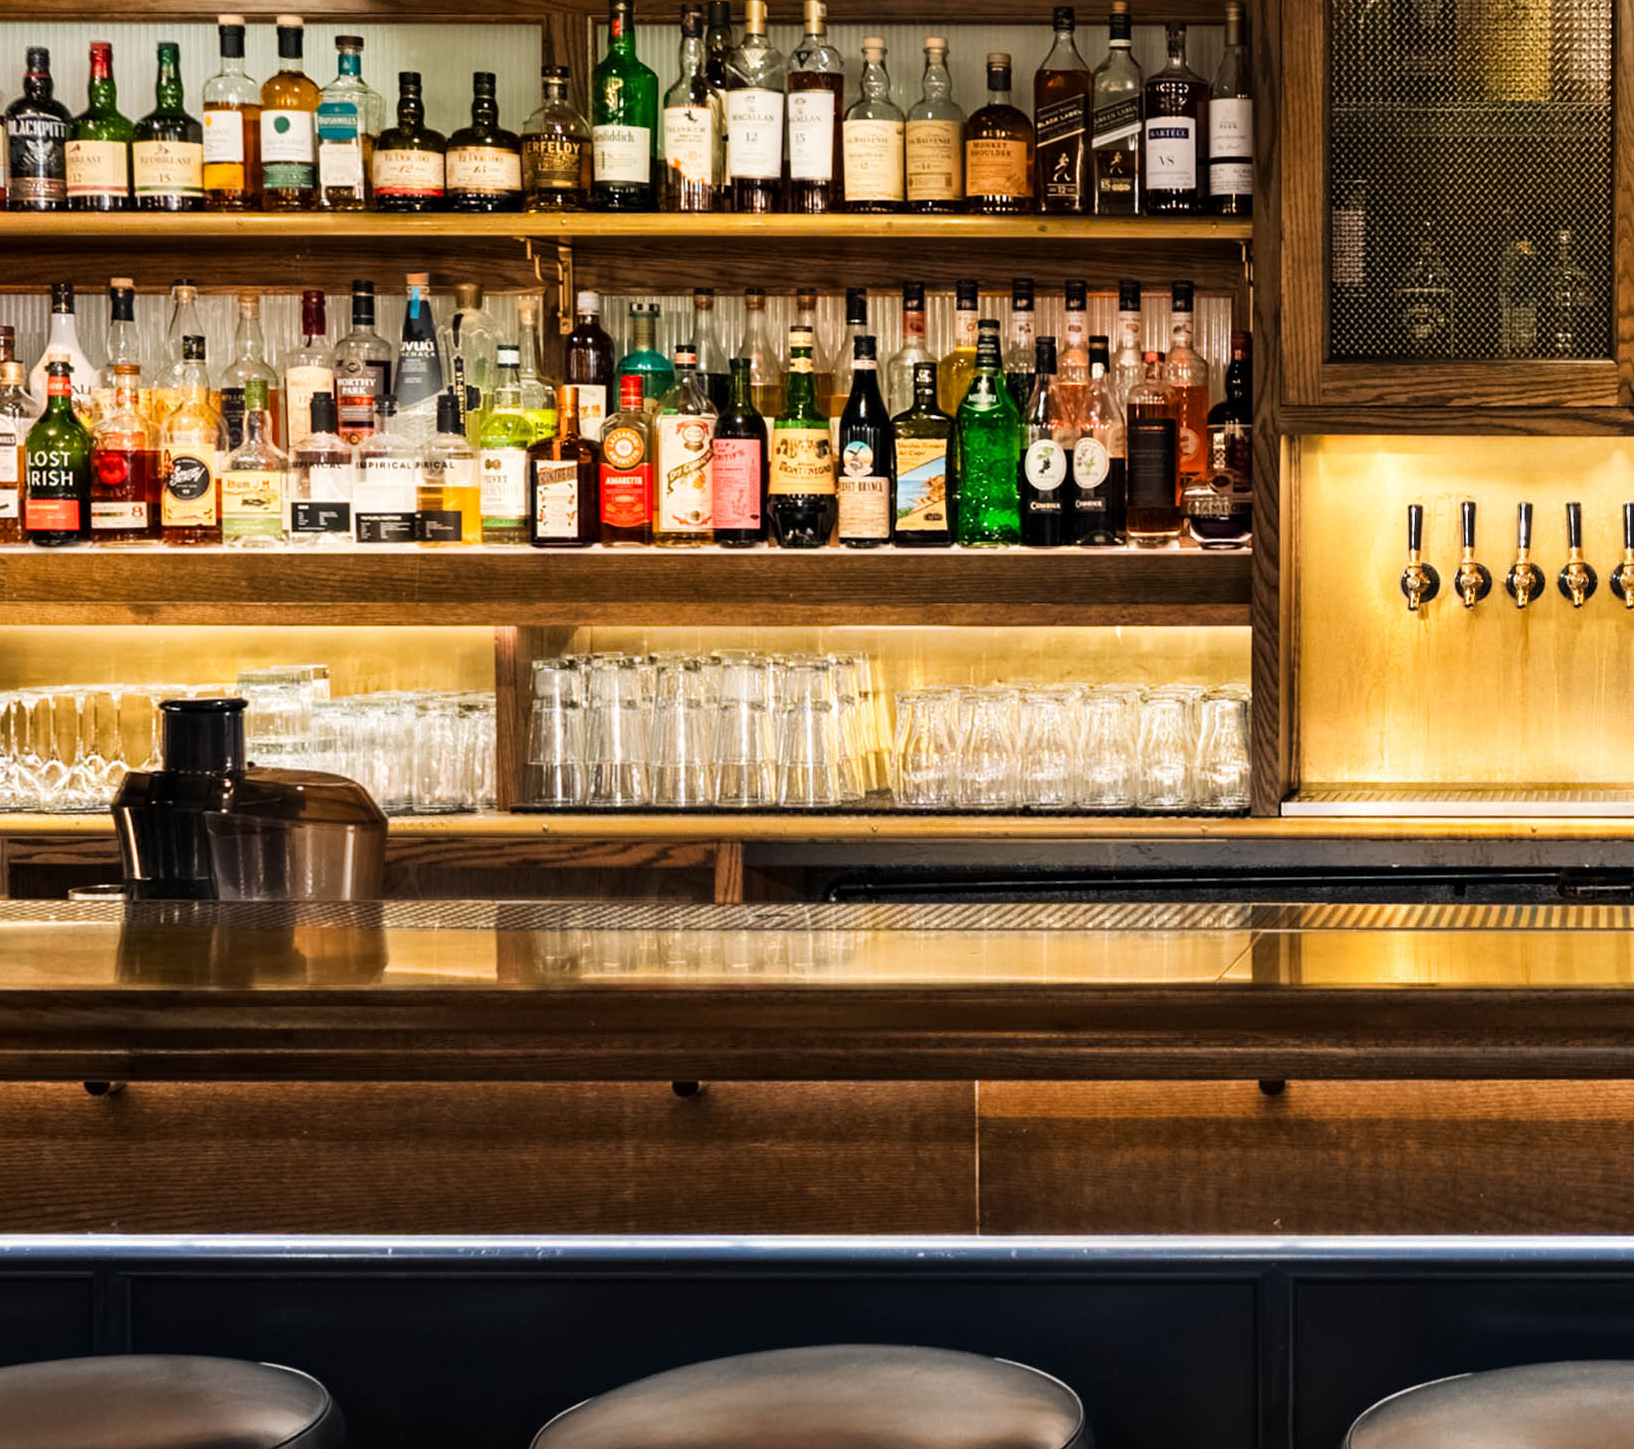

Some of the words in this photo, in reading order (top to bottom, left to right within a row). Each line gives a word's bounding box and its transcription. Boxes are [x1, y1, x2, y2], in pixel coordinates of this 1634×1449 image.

[732, 114, 775, 122] MACALLAN
[1058, 109, 1083, 122] LABEL
[318, 116, 357, 127] BUSHMILLS
[745, 132, 758, 142] 12
[1149, 128, 1188, 138] MARTELL
[526, 141, 581, 156] ERFELDY
[970, 149, 1012, 157] SHOULDER
[1159, 155, 1175, 166] VS
[342, 386, 366, 395] PARK
[968, 393, 997, 402] MIDORI
[27, 452, 70, 467] LOST
[778, 464, 831, 474] MONTENEGRO
[28, 471, 74, 486] IRISH
[605, 476, 643, 485] AMARETTO
[1030, 501, 1061, 510] COMBIER
[1075, 499, 1103, 508] COMBIER
[131, 503, 143, 517] 8
